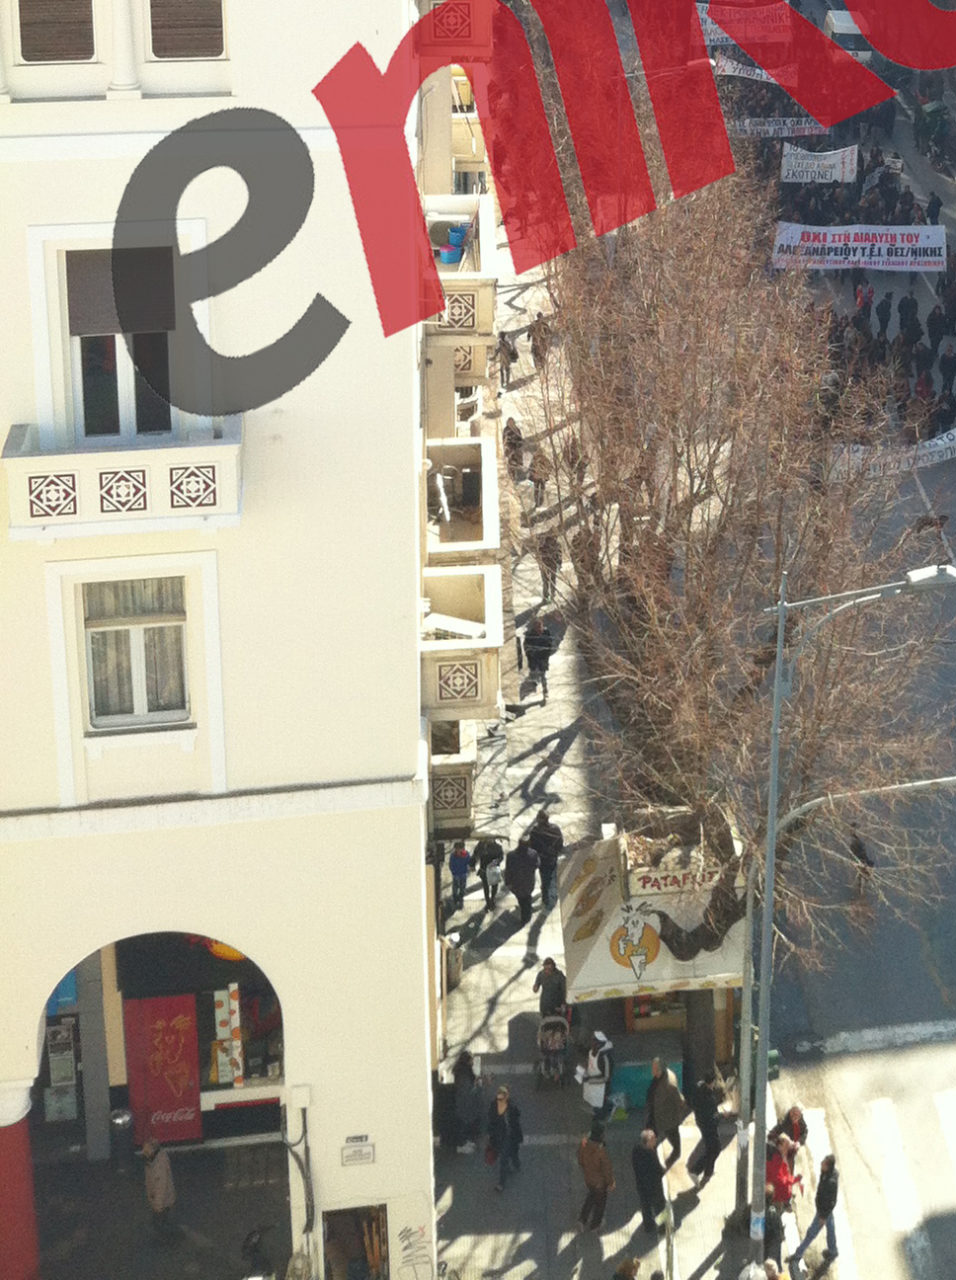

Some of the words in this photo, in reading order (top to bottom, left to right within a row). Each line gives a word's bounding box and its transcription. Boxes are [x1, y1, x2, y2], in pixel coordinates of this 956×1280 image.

[800, 231, 828, 243] ΟΧΙ
[831, 233, 851, 243] ΣΤΗ
[900, 233, 920, 243] ΤΟΥ
